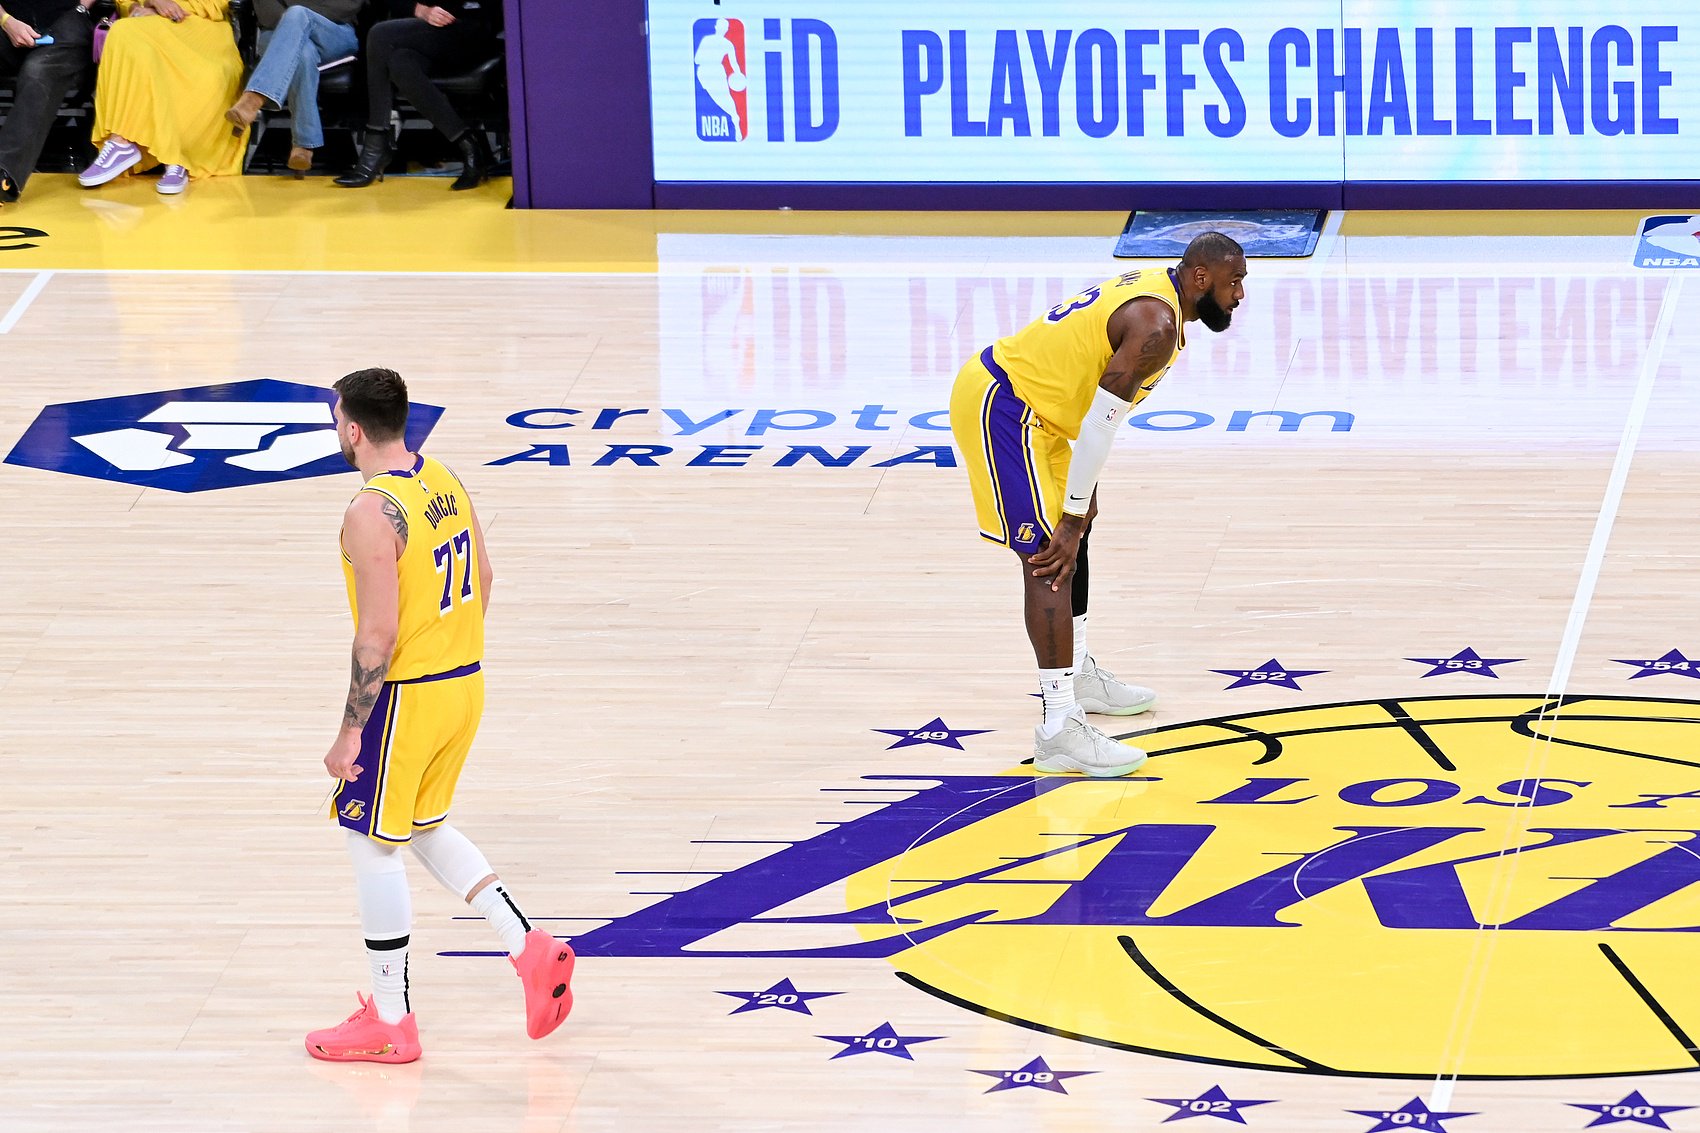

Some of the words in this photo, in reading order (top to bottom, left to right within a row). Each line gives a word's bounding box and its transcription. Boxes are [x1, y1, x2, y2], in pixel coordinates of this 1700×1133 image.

[763, 18, 840, 142] iD
[903, 27, 1247, 138] PLAYOFFS
[1268, 25, 1679, 138] CHALLENGE
[702, 116, 730, 137] NBA
[1642, 257, 1699, 266] NBA
[1043, 285, 1101, 324] 3
[482, 443, 959, 467] ARENA
[432, 527, 474, 619] 77
[1196, 777, 1593, 808] LOS
